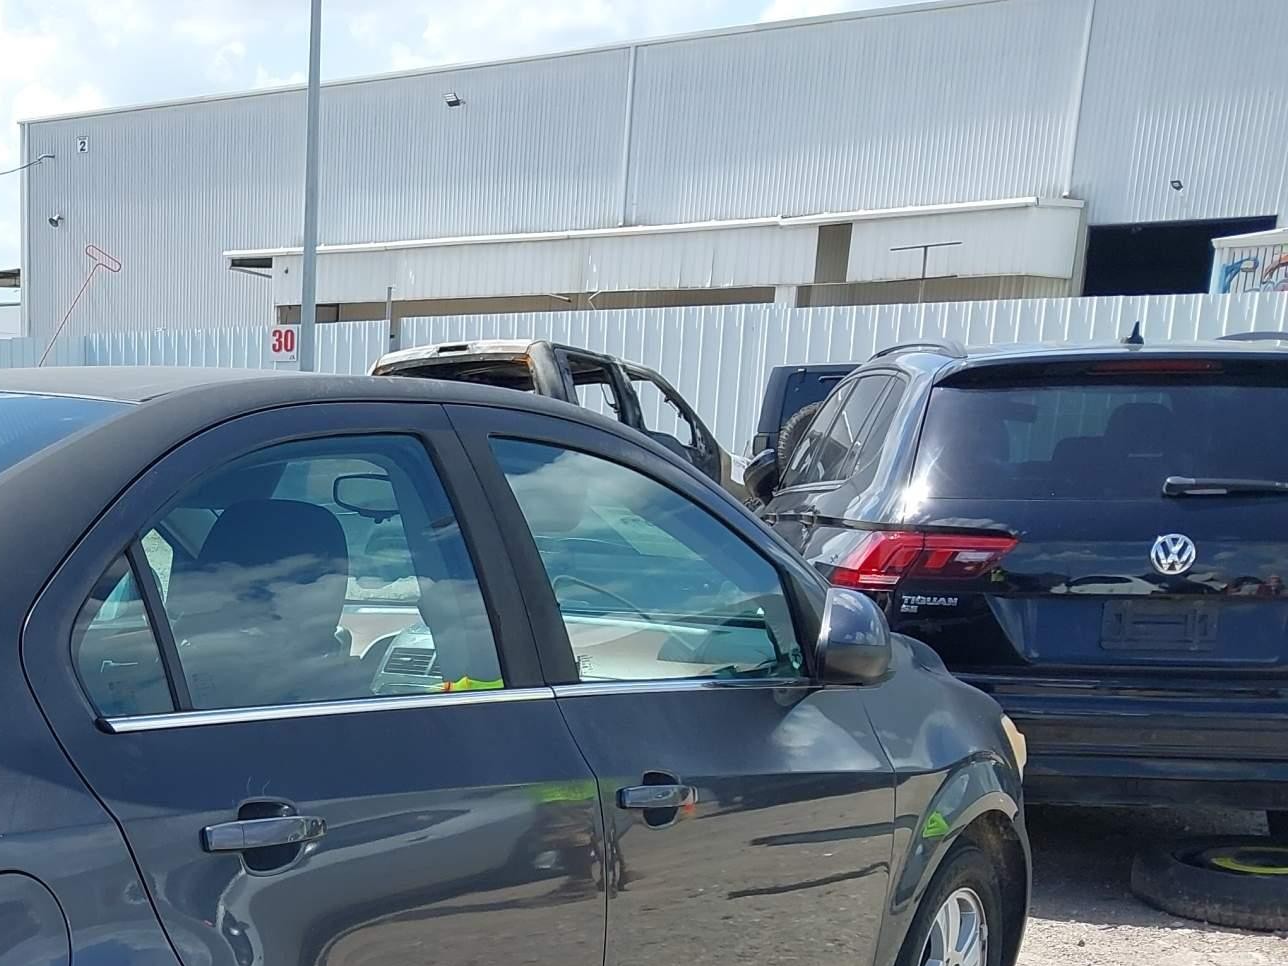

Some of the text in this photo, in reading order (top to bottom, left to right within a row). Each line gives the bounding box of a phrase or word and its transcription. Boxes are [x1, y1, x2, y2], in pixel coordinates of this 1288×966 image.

[79, 140, 87, 152] 2
[272, 329, 295, 353] 30
[901, 595, 959, 607] TIGUAN
